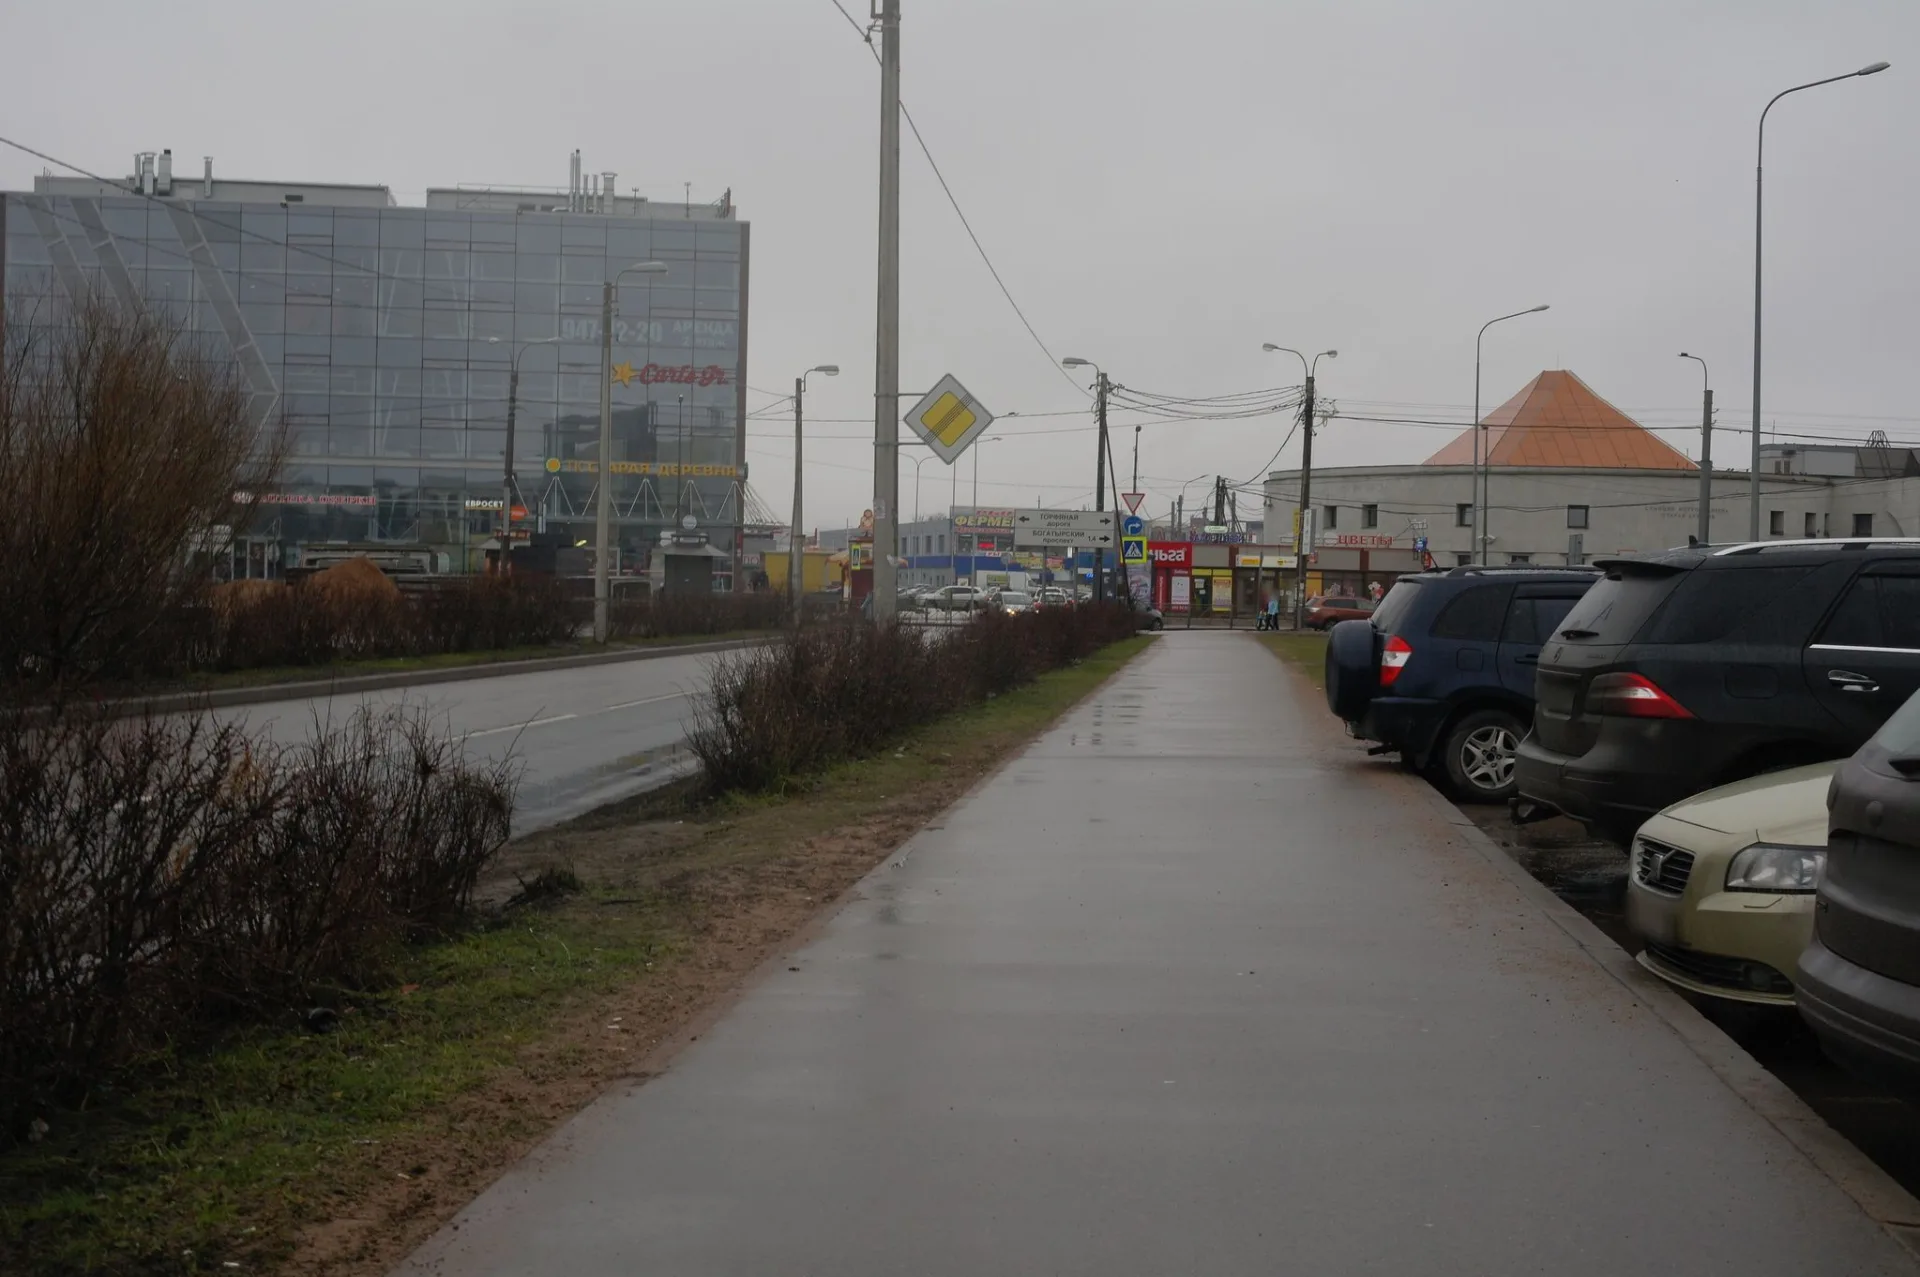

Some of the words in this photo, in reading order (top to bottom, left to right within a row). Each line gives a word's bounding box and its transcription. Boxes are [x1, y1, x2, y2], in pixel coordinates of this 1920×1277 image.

[562, 319, 664, 343] 947-2-20
[672, 320, 734, 336] АРЕНДА
[587, 461, 652, 474] САРАЯ
[658, 464, 737, 477] ДЕРЕВНЯ
[465, 500, 504, 508] ЕВРОСЕТ
[1338, 535, 1393, 546] ЦВЕТЫ
